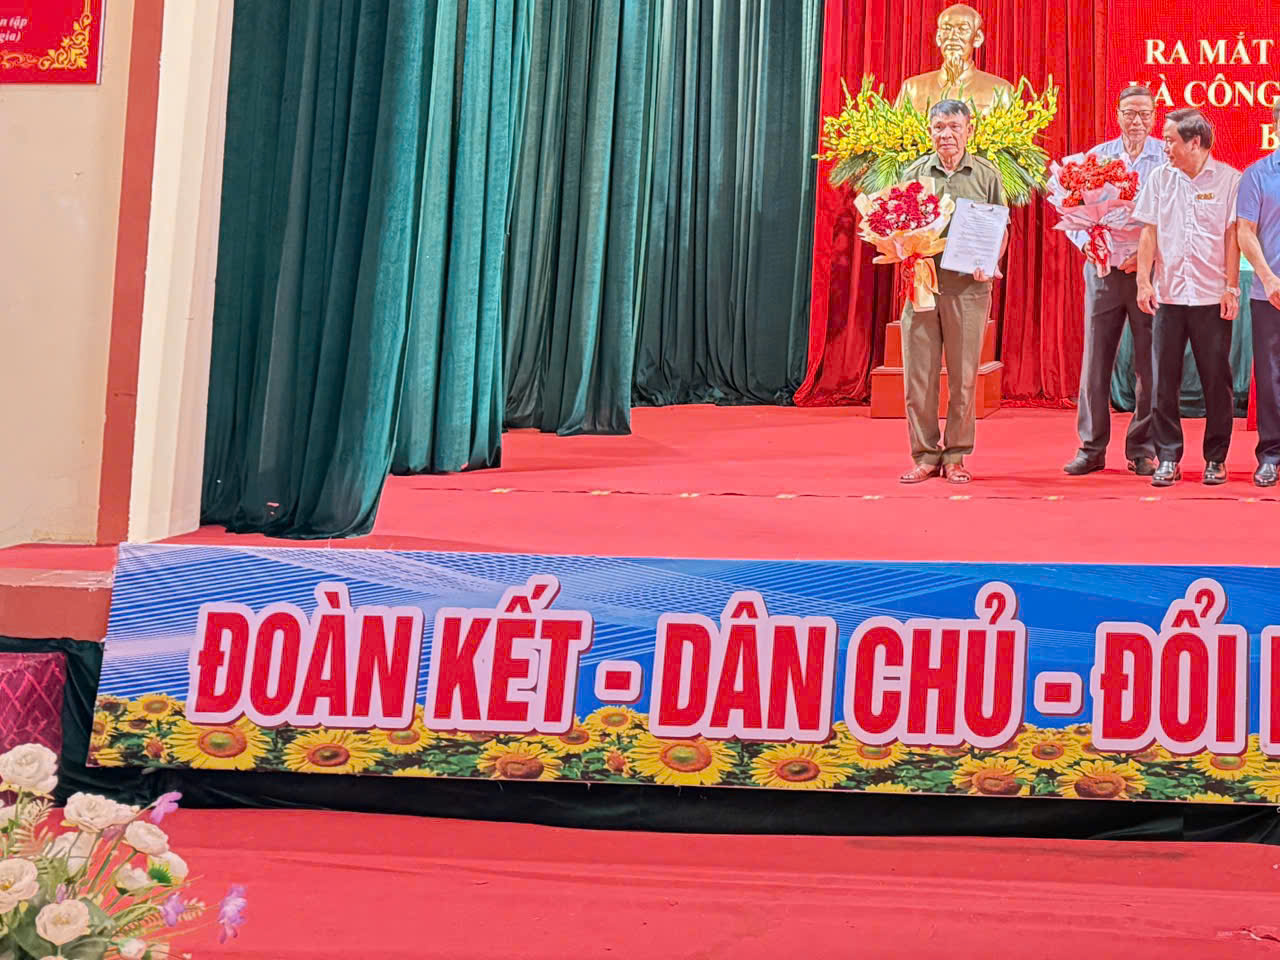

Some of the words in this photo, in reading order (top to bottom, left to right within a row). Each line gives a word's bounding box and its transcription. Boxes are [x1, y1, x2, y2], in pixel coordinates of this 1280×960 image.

[1144, 39, 1191, 65] RA
[1199, 31, 1275, 66] MẮT
[194, 587, 414, 718] ĐOÀN
[433, 580, 582, 723] KẾT
[658, 600, 827, 731] DÂN
[853, 590, 1016, 738] CHỦ
[1100, 588, 1237, 743] ĐỔI
